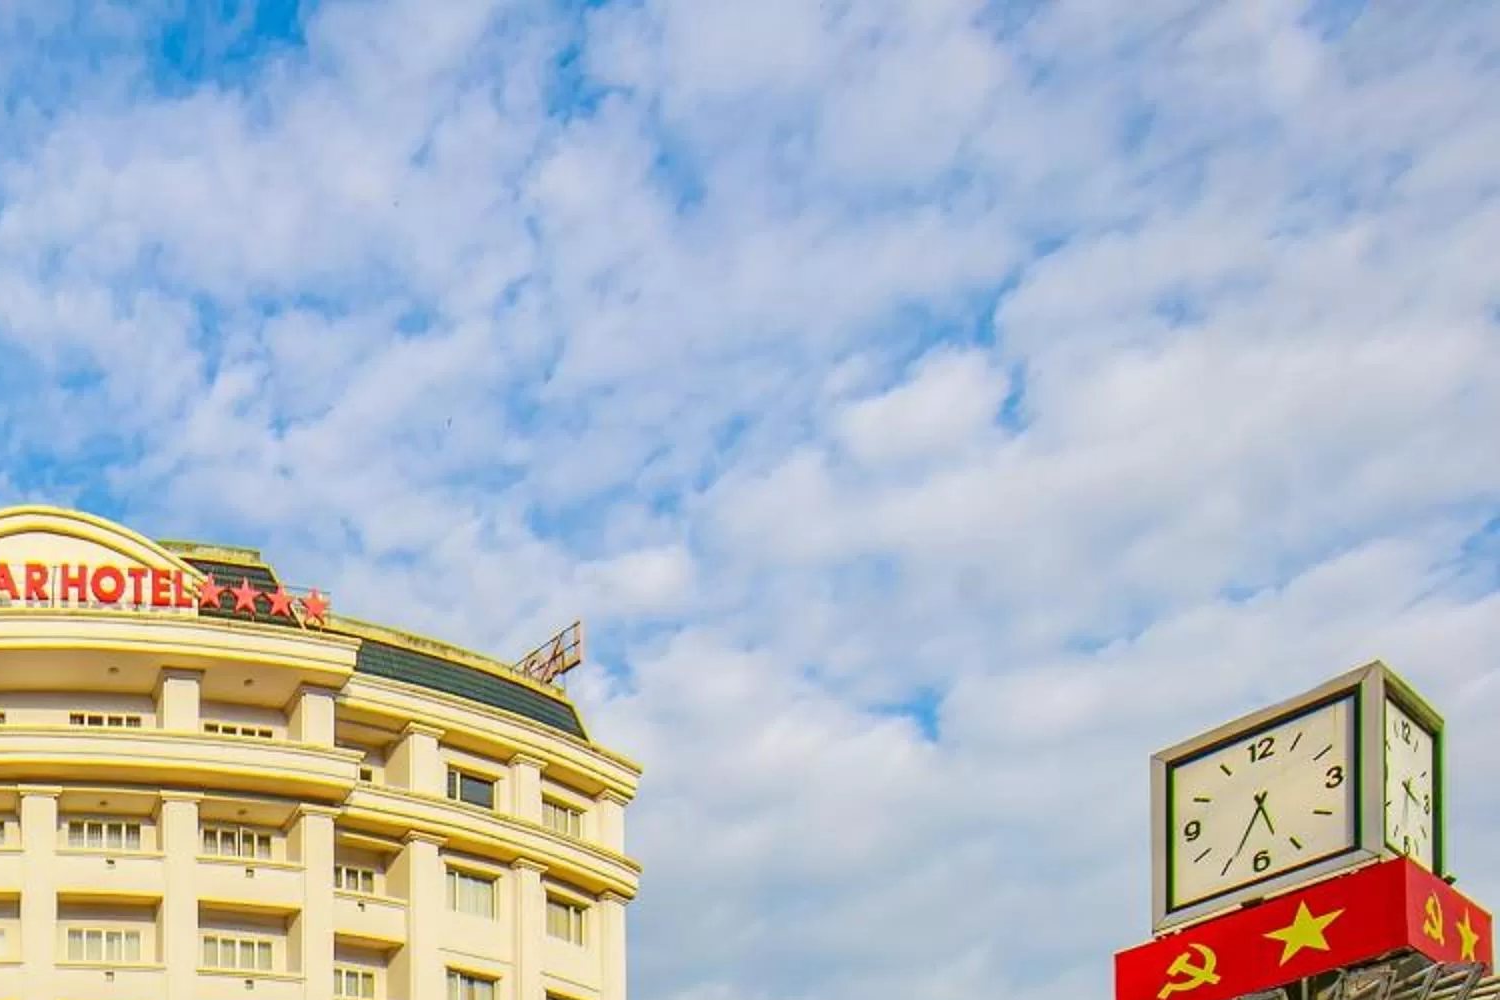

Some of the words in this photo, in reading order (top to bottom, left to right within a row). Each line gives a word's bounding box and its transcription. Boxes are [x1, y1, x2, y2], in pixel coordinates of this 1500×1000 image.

[60, 562, 194, 608] HOTEL
[1246, 736, 1276, 763] 12
[1324, 765, 1344, 789] 3
[1184, 820, 1201, 841] 9
[1253, 850, 1271, 873] 6
